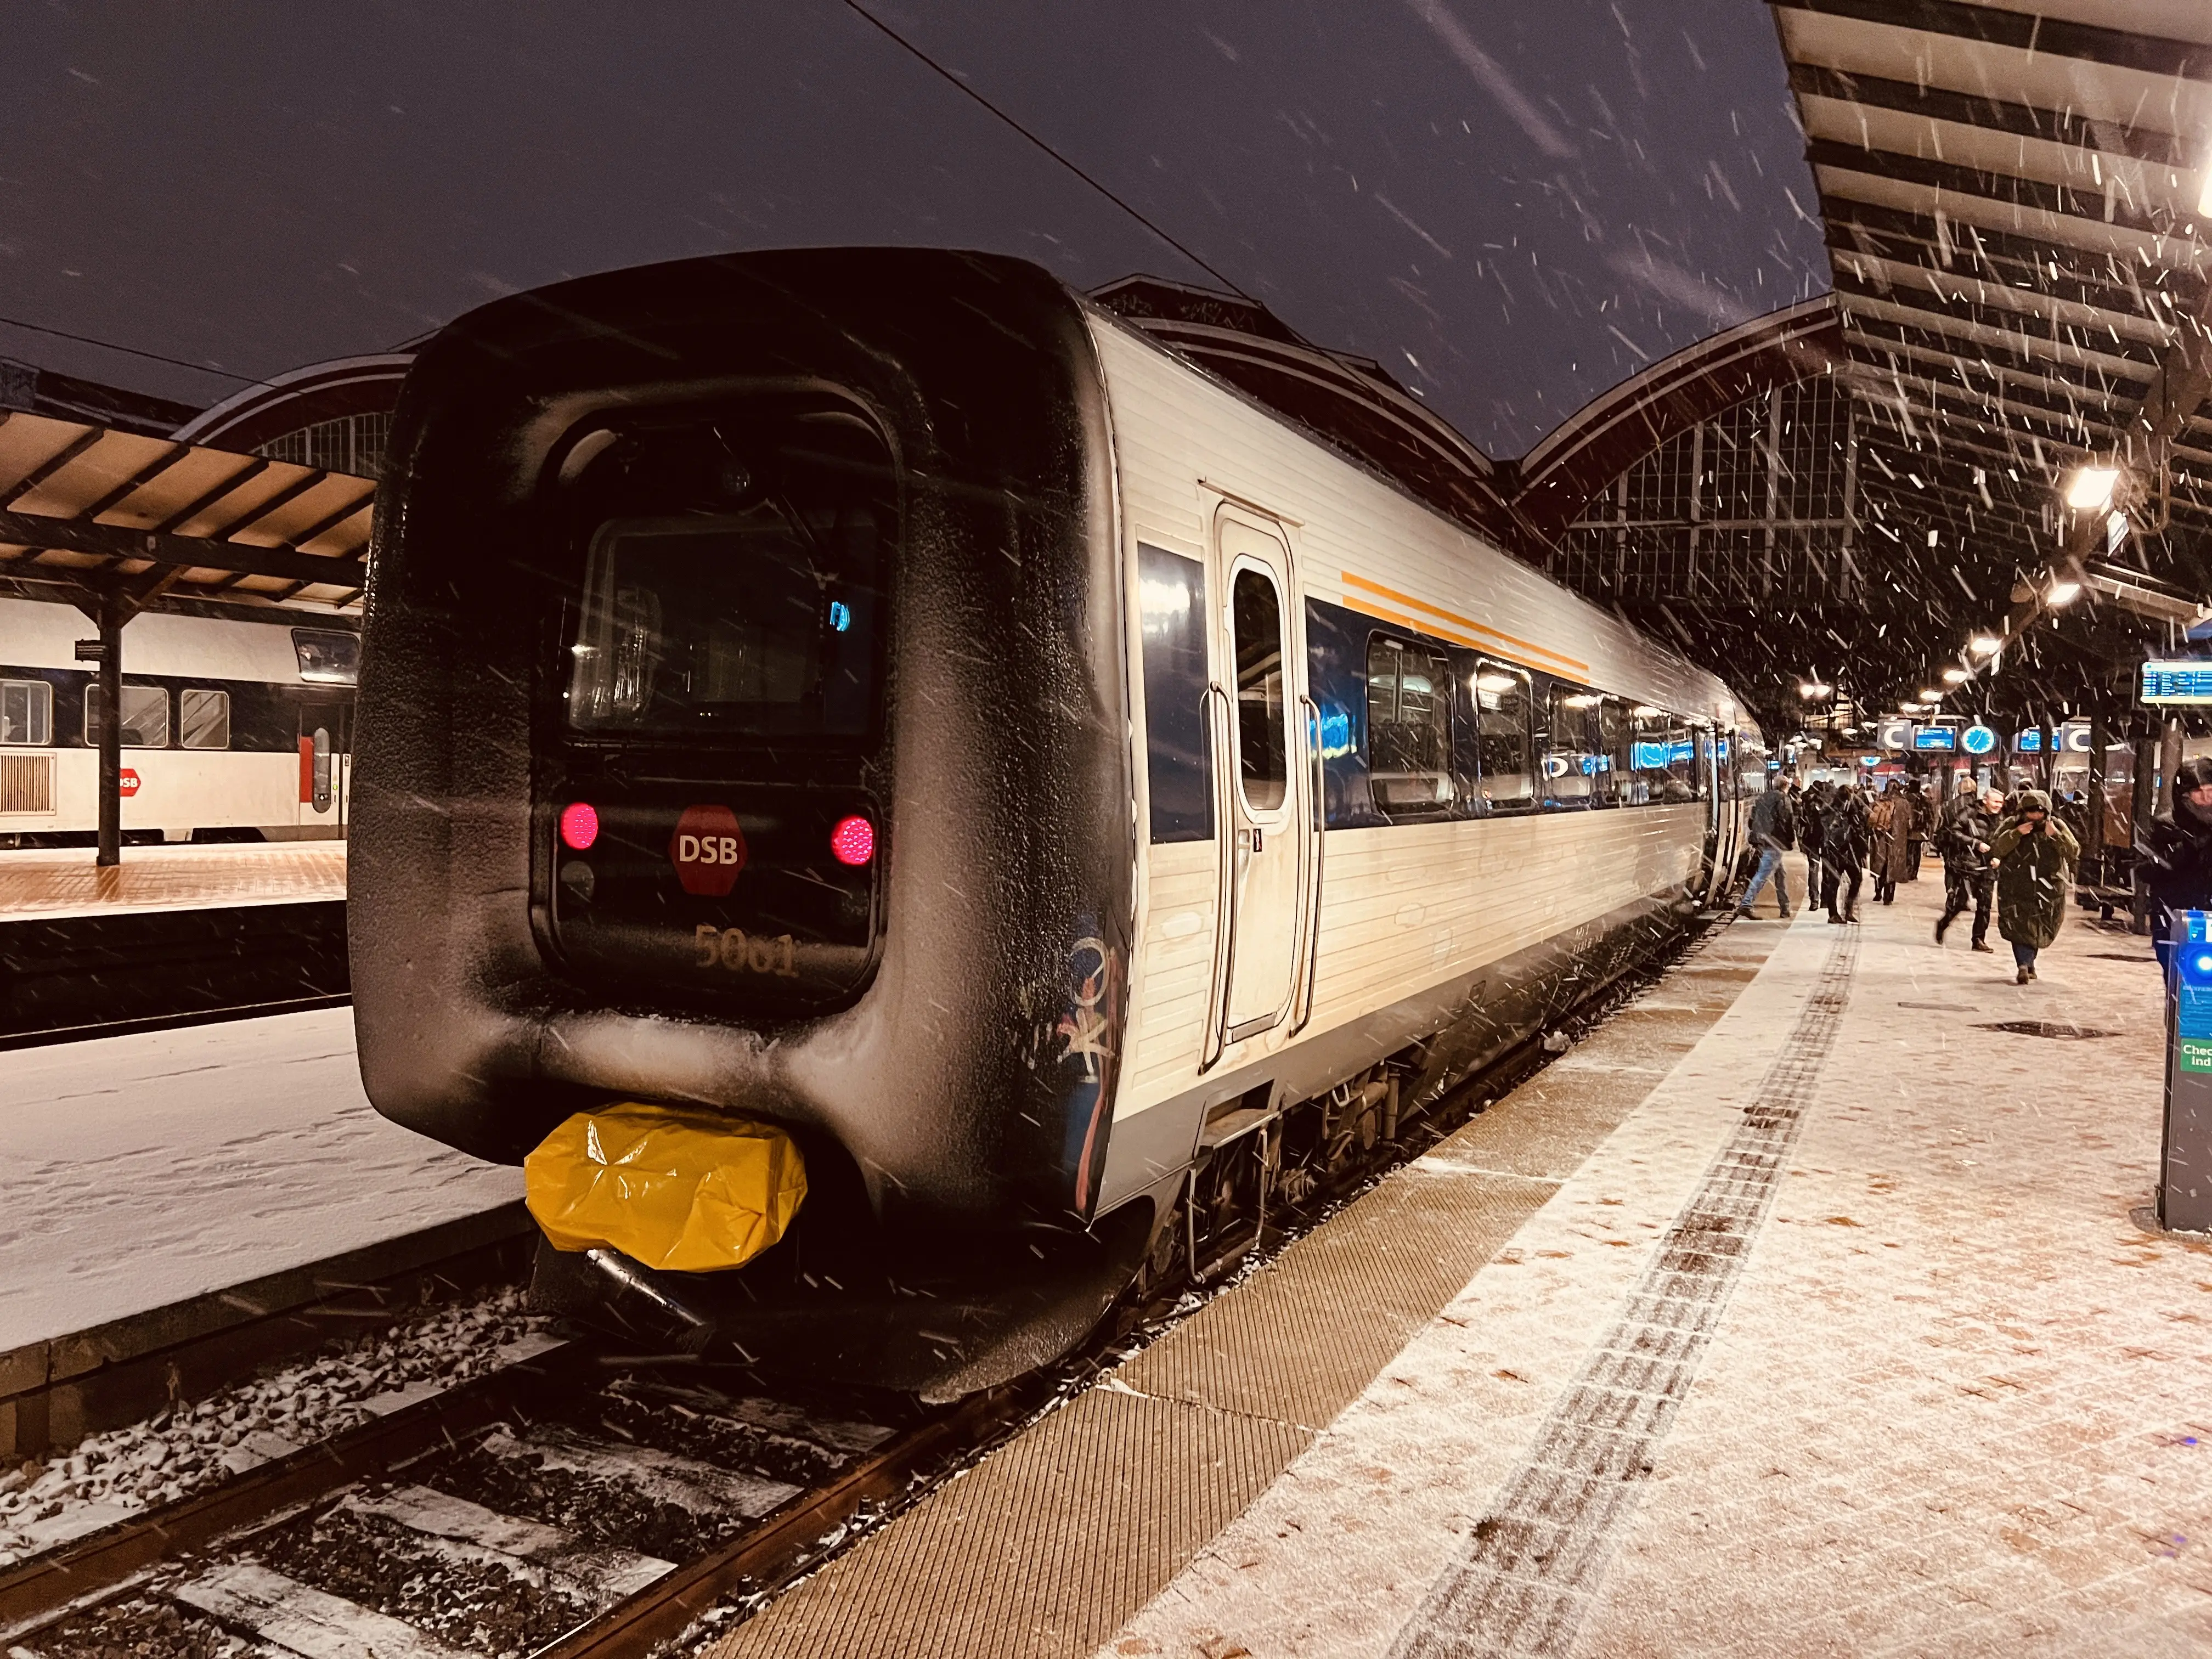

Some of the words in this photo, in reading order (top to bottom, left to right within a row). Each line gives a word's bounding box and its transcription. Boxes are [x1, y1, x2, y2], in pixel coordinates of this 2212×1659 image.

[1883, 726, 1904, 748] C
[2068, 729, 2090, 752] C
[679, 835, 738, 865] DSB
[2192, 1056, 2211, 1066] Ind
